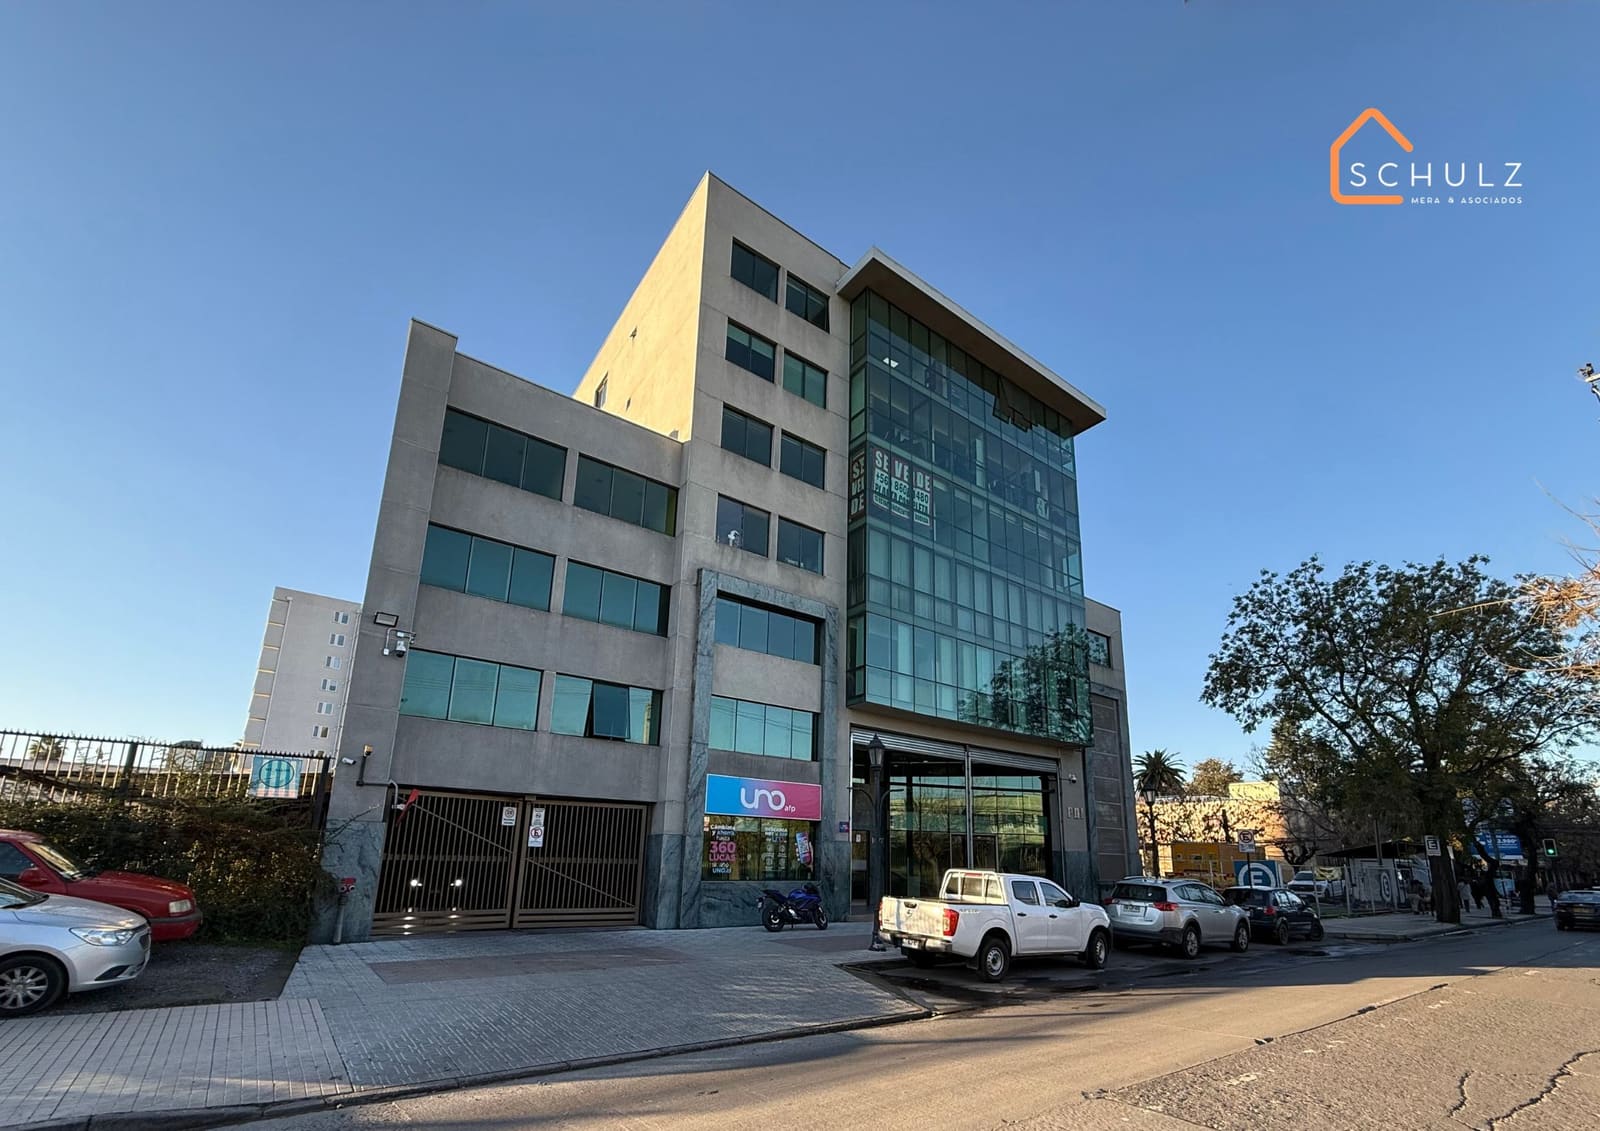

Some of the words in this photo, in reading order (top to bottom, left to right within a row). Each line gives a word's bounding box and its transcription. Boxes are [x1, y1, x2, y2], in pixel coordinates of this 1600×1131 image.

[875, 450, 889, 472] SE
[740, 787, 786, 811] uno
[784, 804, 796, 813] afp
[709, 841, 737, 853] 360
[709, 853, 736, 862] LUCAS
